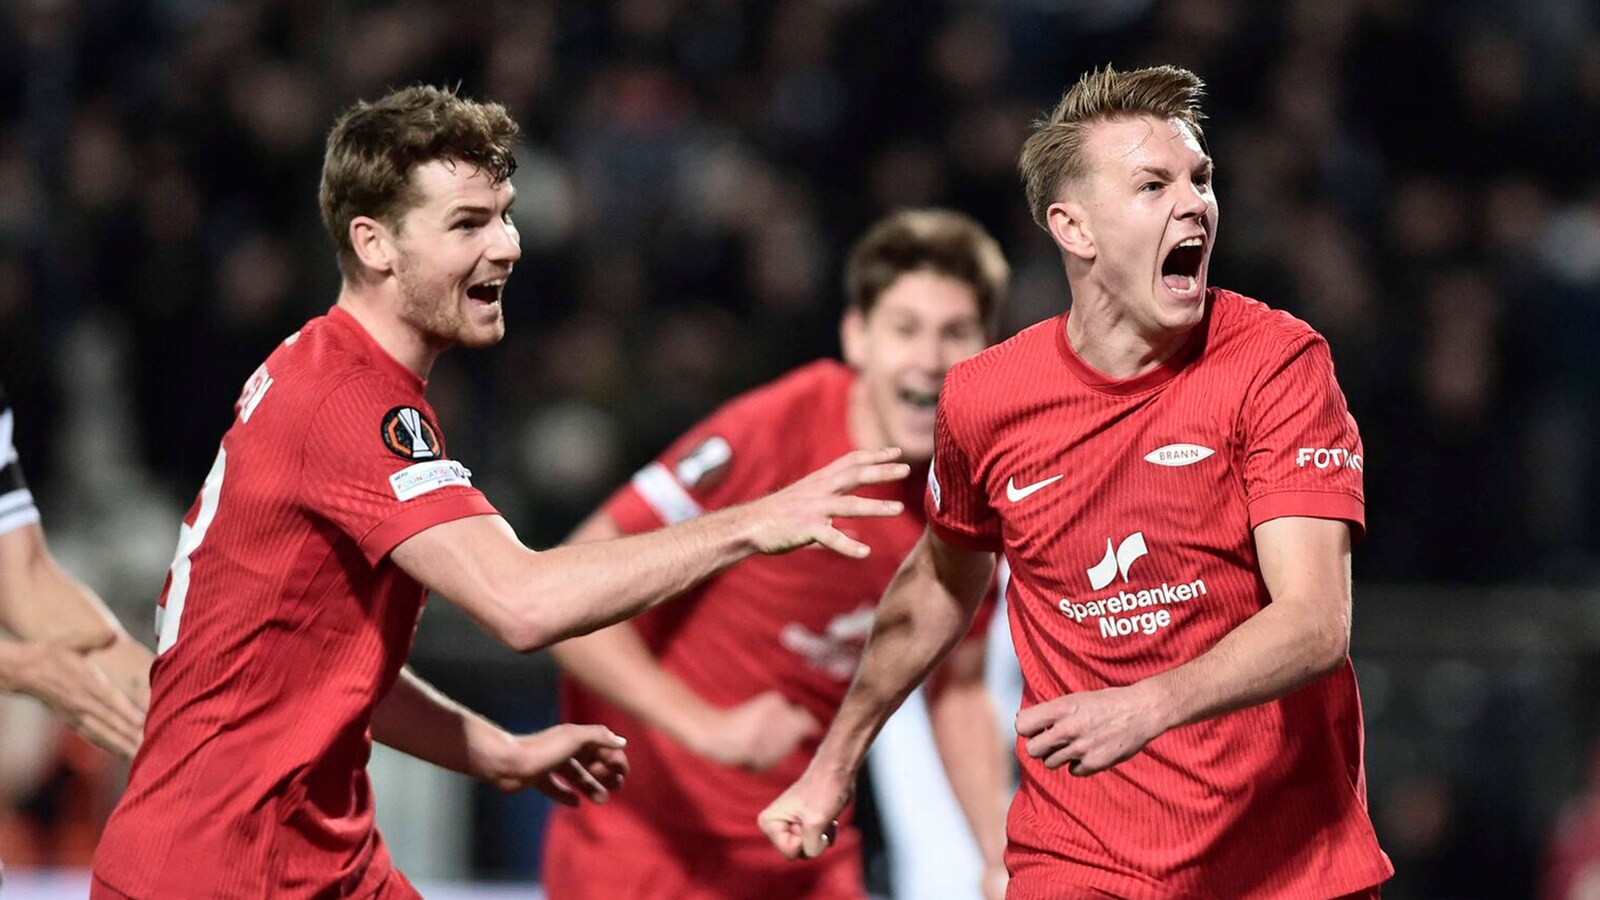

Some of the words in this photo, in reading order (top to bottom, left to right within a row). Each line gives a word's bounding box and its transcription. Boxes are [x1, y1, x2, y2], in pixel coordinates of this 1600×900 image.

[1159, 449, 1199, 460] BRANN
[1059, 578, 1207, 623] Sparebanken
[1099, 609, 1171, 639] Norge
